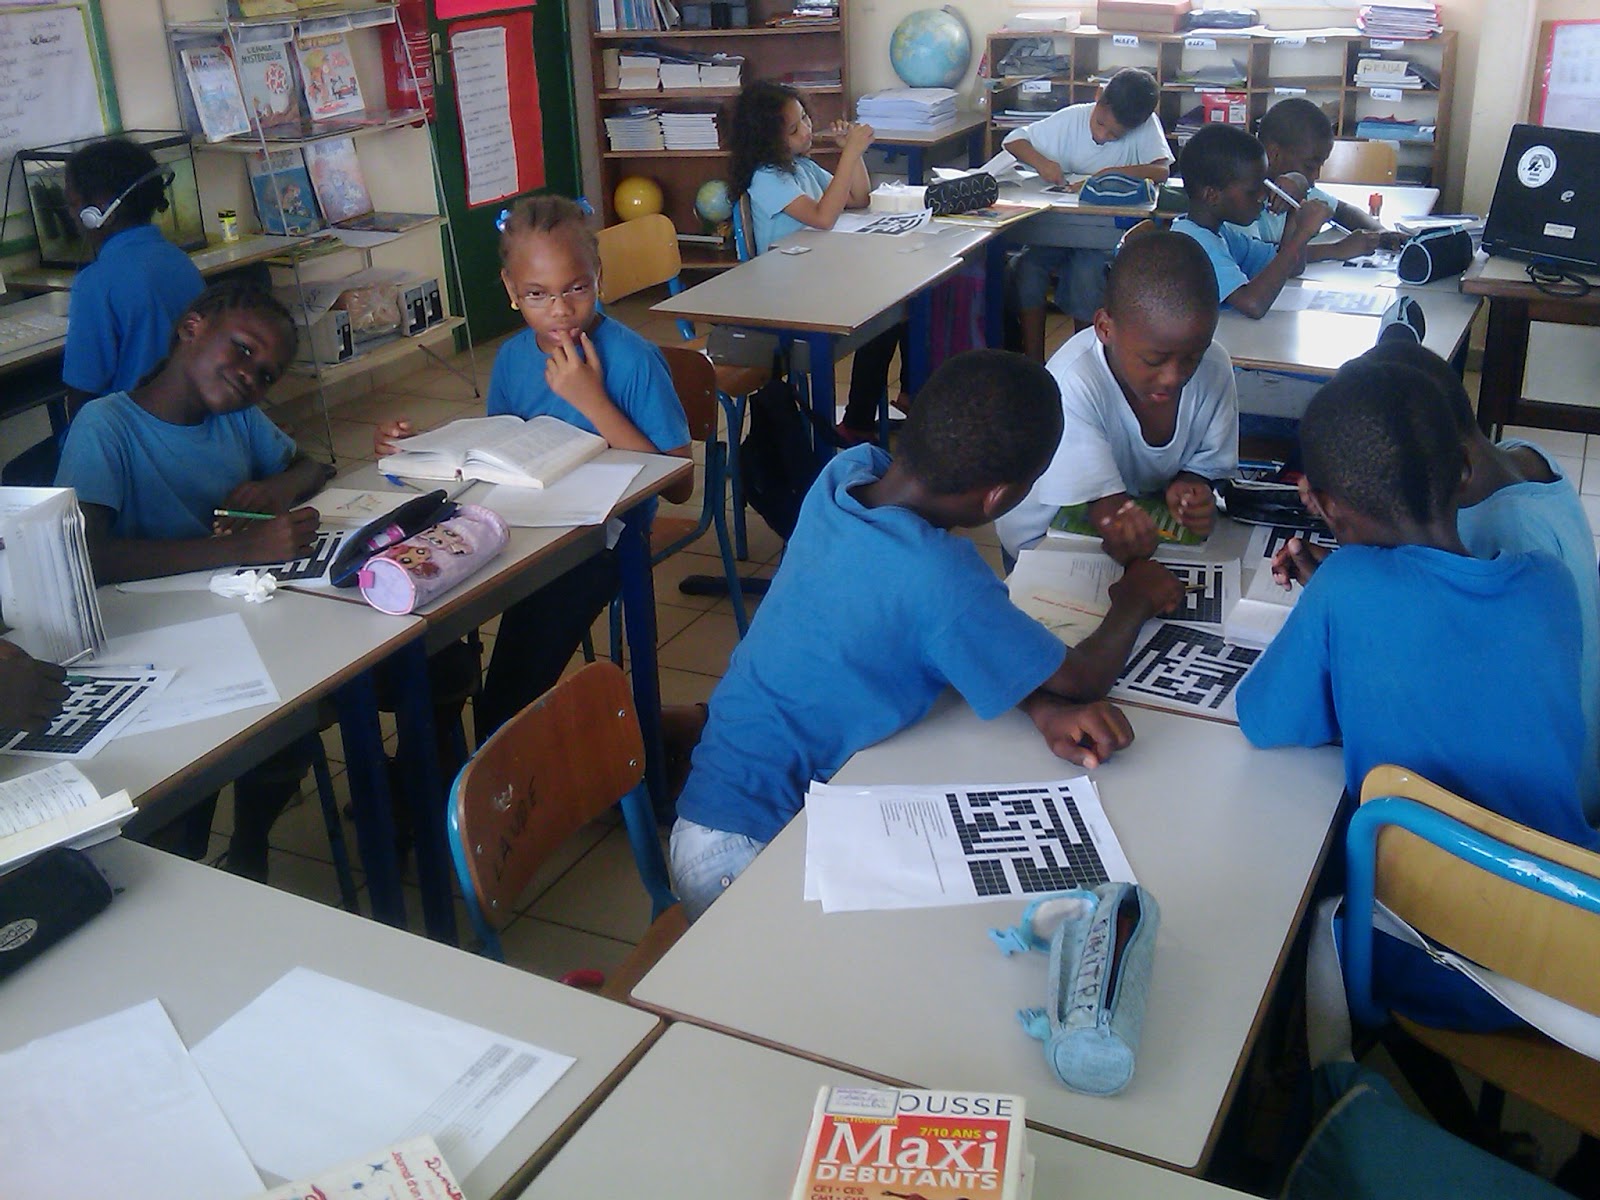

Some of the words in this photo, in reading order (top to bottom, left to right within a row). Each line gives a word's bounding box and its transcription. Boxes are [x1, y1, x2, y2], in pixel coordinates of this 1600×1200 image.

[898, 1094, 1014, 1118] OUSSE
[919, 1127, 948, 1138] 7/10
[952, 1128, 982, 1139] ANS
[818, 1122, 1000, 1174] Maxi
[813, 1184, 833, 1193] CE1
[815, 1165, 998, 1190] DEBUTANTS
